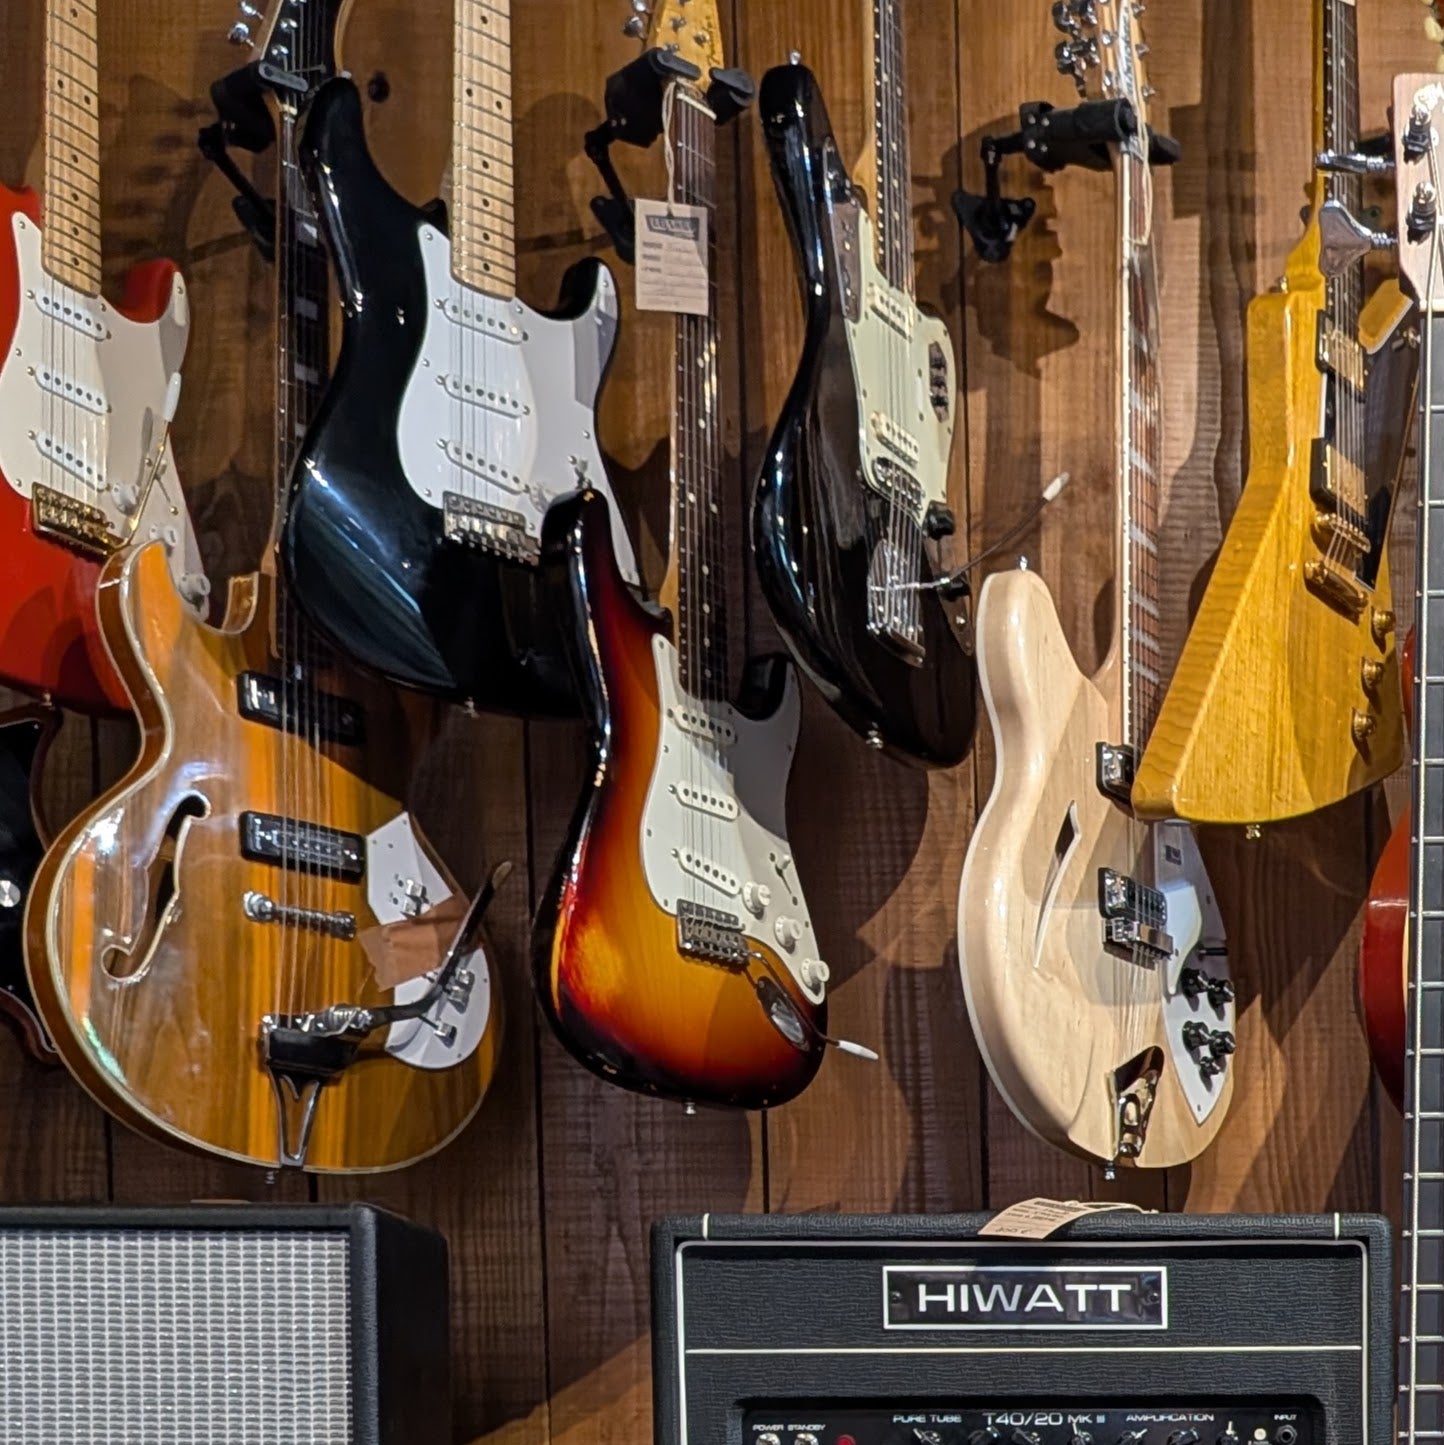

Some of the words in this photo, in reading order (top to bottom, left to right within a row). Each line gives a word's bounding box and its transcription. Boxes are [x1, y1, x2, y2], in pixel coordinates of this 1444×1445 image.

[918, 1284, 1132, 1312] HIWATT
[893, 1415, 926, 1423] PURE
[931, 1415, 962, 1423] TUBE
[982, 1412, 1063, 1426] T40/20
[1067, 1415, 1093, 1424] MK
[1126, 1414, 1215, 1422] AMPLIFICATION
